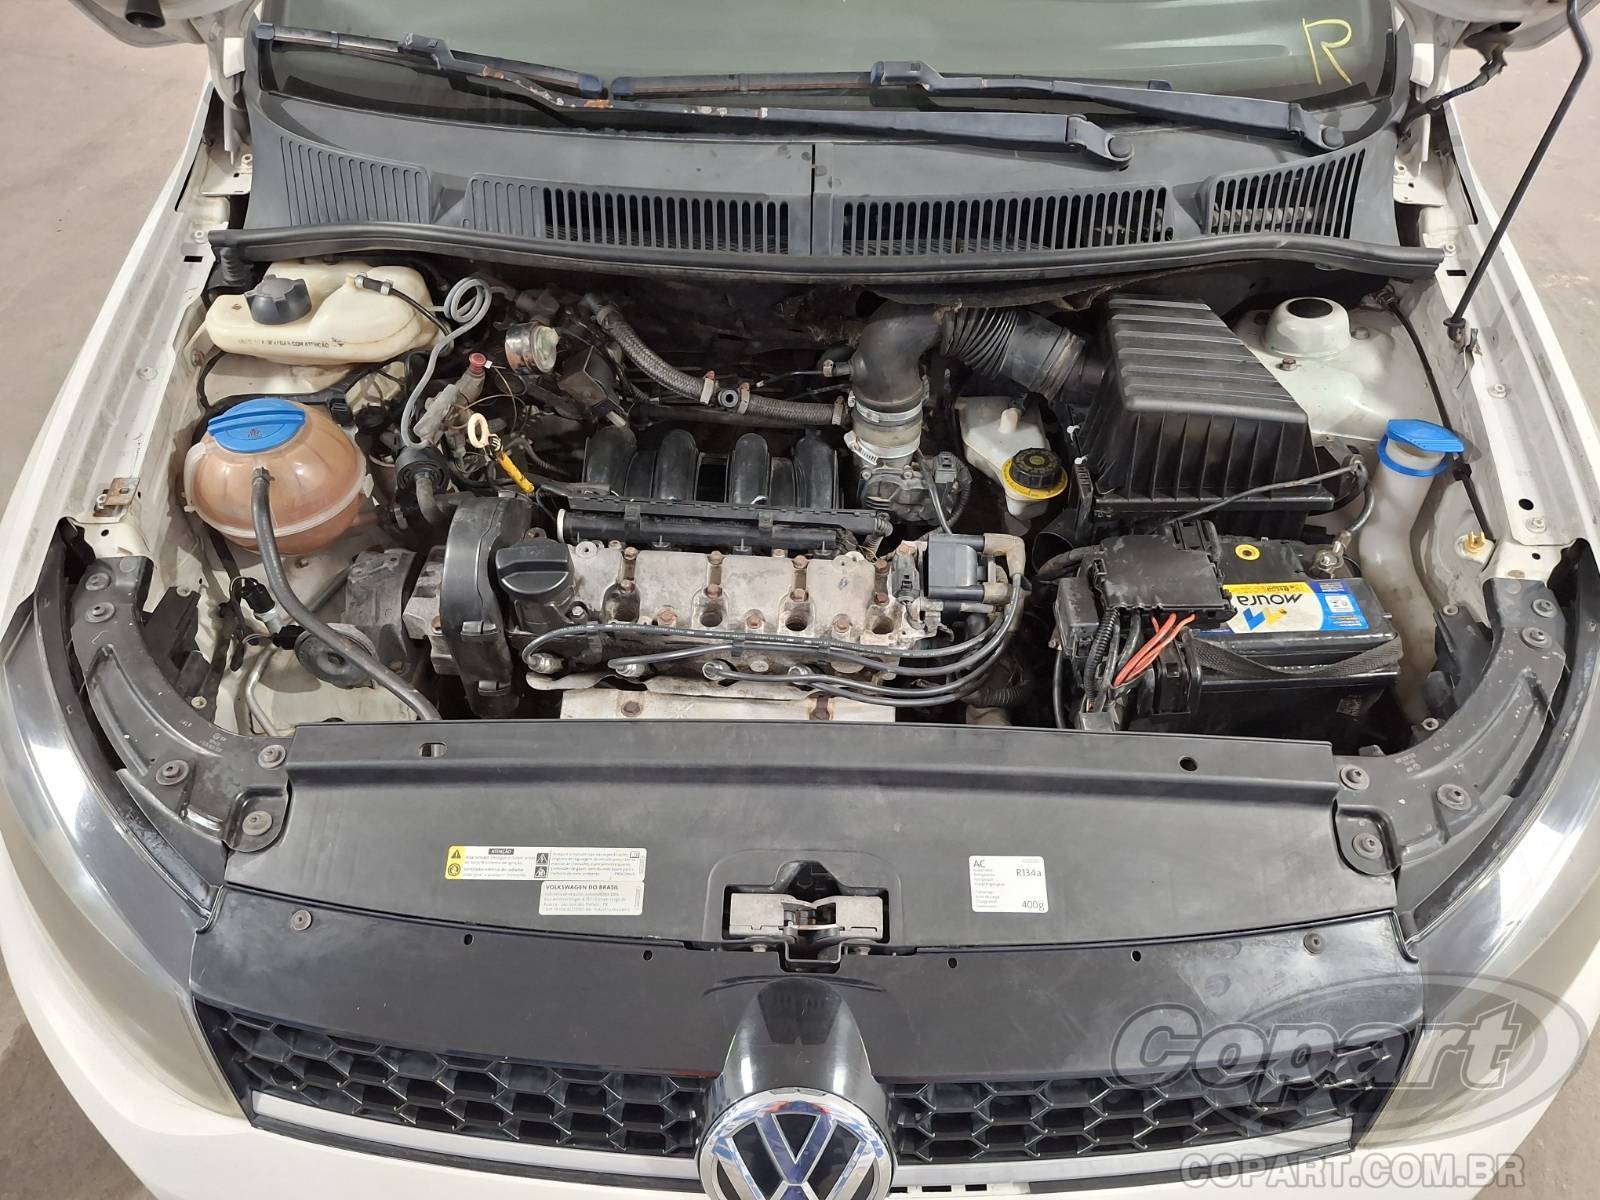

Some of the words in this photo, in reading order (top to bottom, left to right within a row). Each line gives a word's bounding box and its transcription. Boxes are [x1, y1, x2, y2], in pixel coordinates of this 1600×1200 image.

[1301, 17, 1353, 86] R
[973, 859, 986, 868] AC
[1016, 868, 1042, 877] R134a
[1022, 900, 1045, 911] 400g
